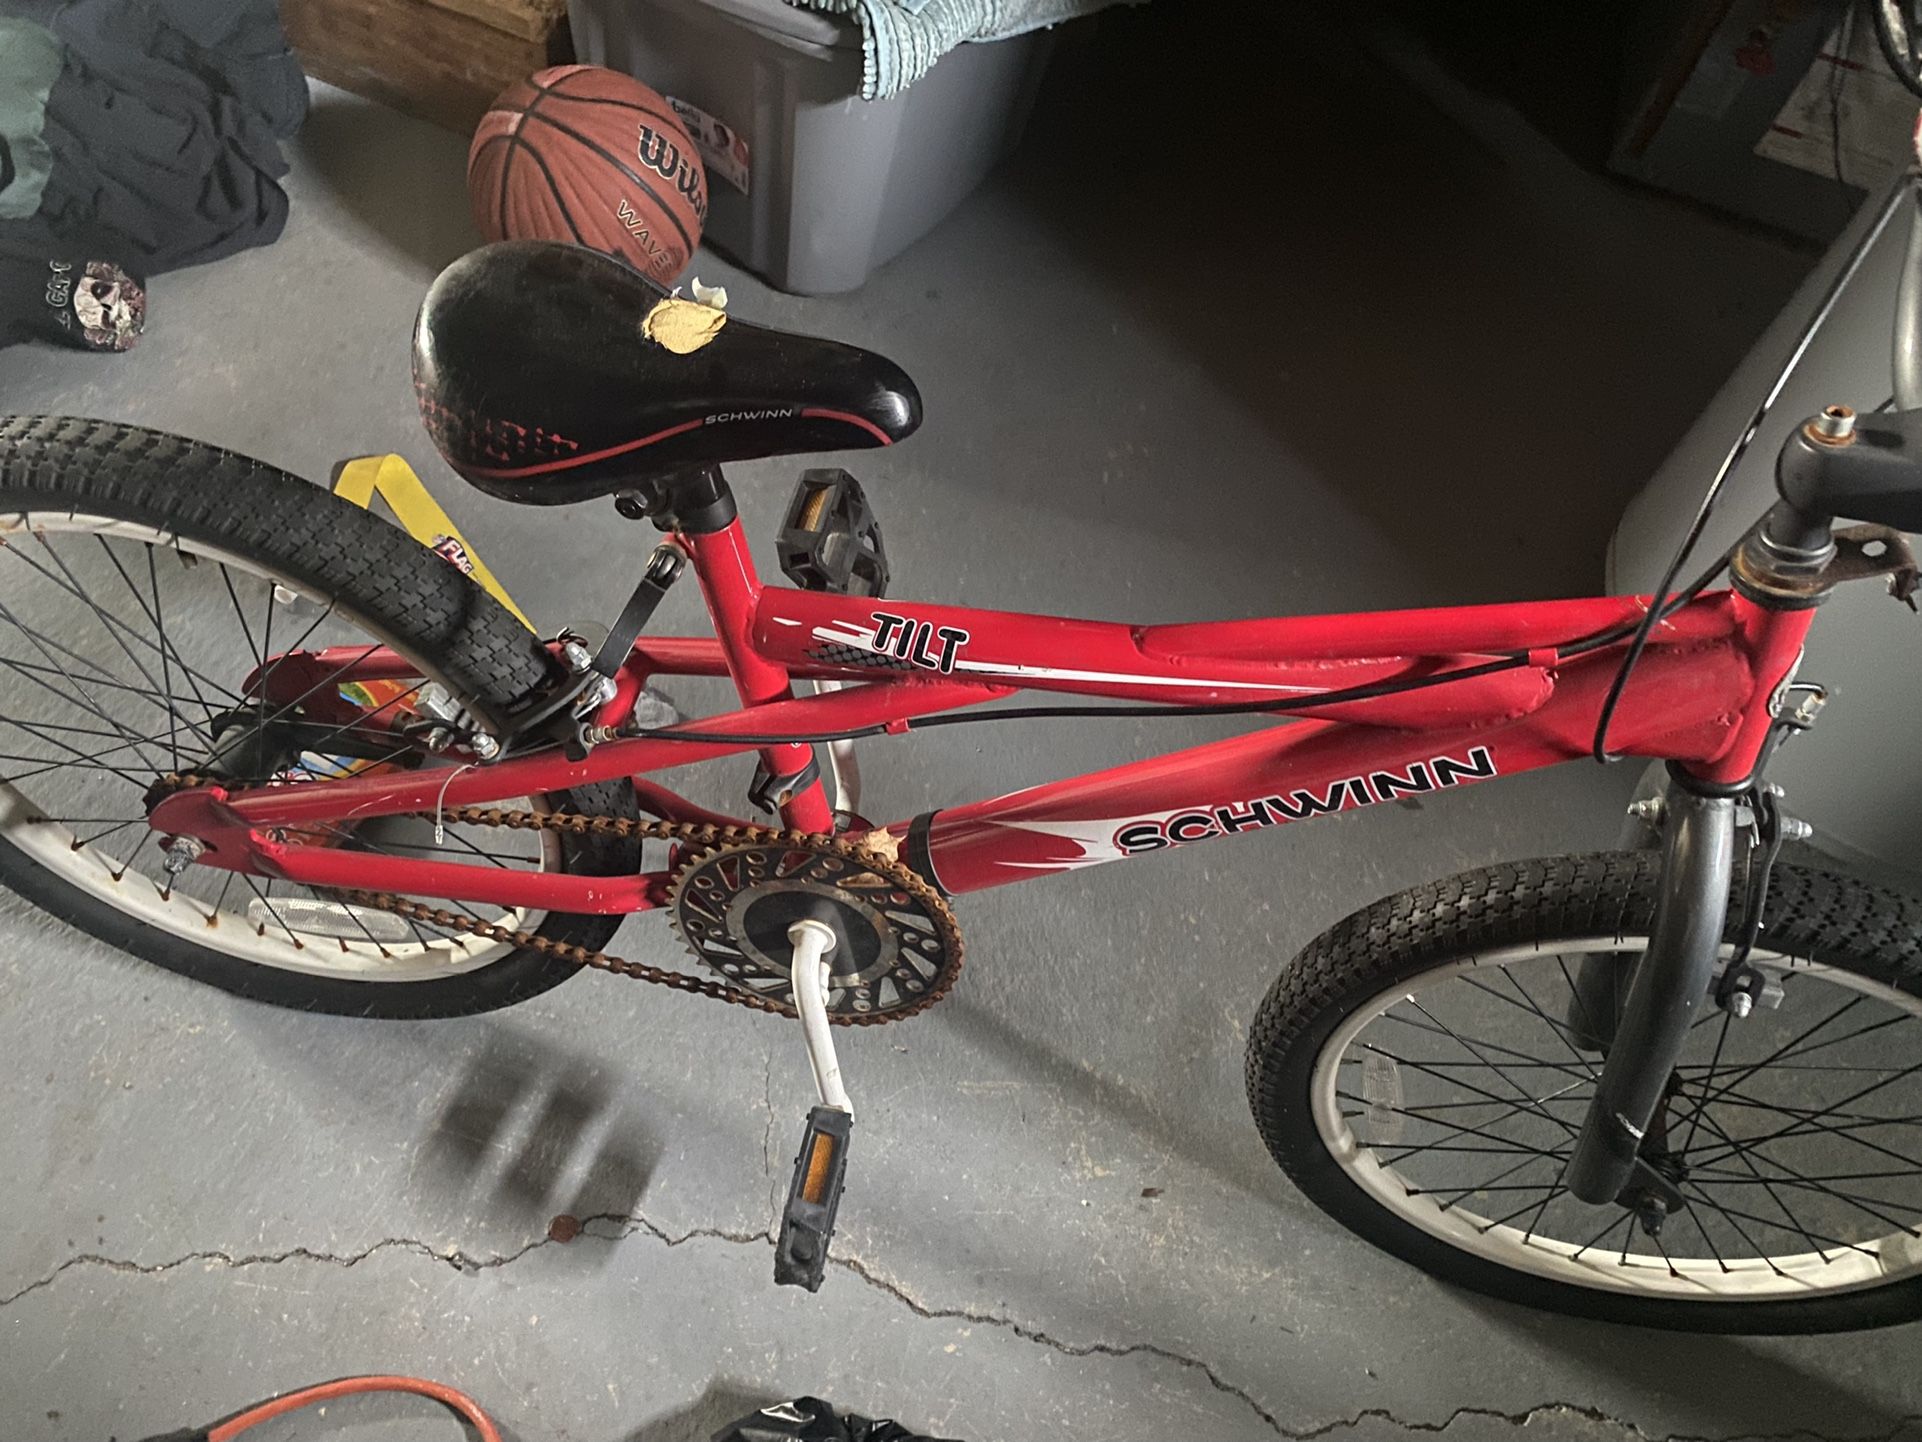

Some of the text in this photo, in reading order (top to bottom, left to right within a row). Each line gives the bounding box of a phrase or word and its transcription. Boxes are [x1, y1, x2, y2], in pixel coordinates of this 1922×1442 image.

[617, 198, 673, 269] WAVE
[705, 408, 793, 425] SCHWINN
[871, 611, 970, 675] TILT
[1117, 747, 1497, 856] SCHWINN
